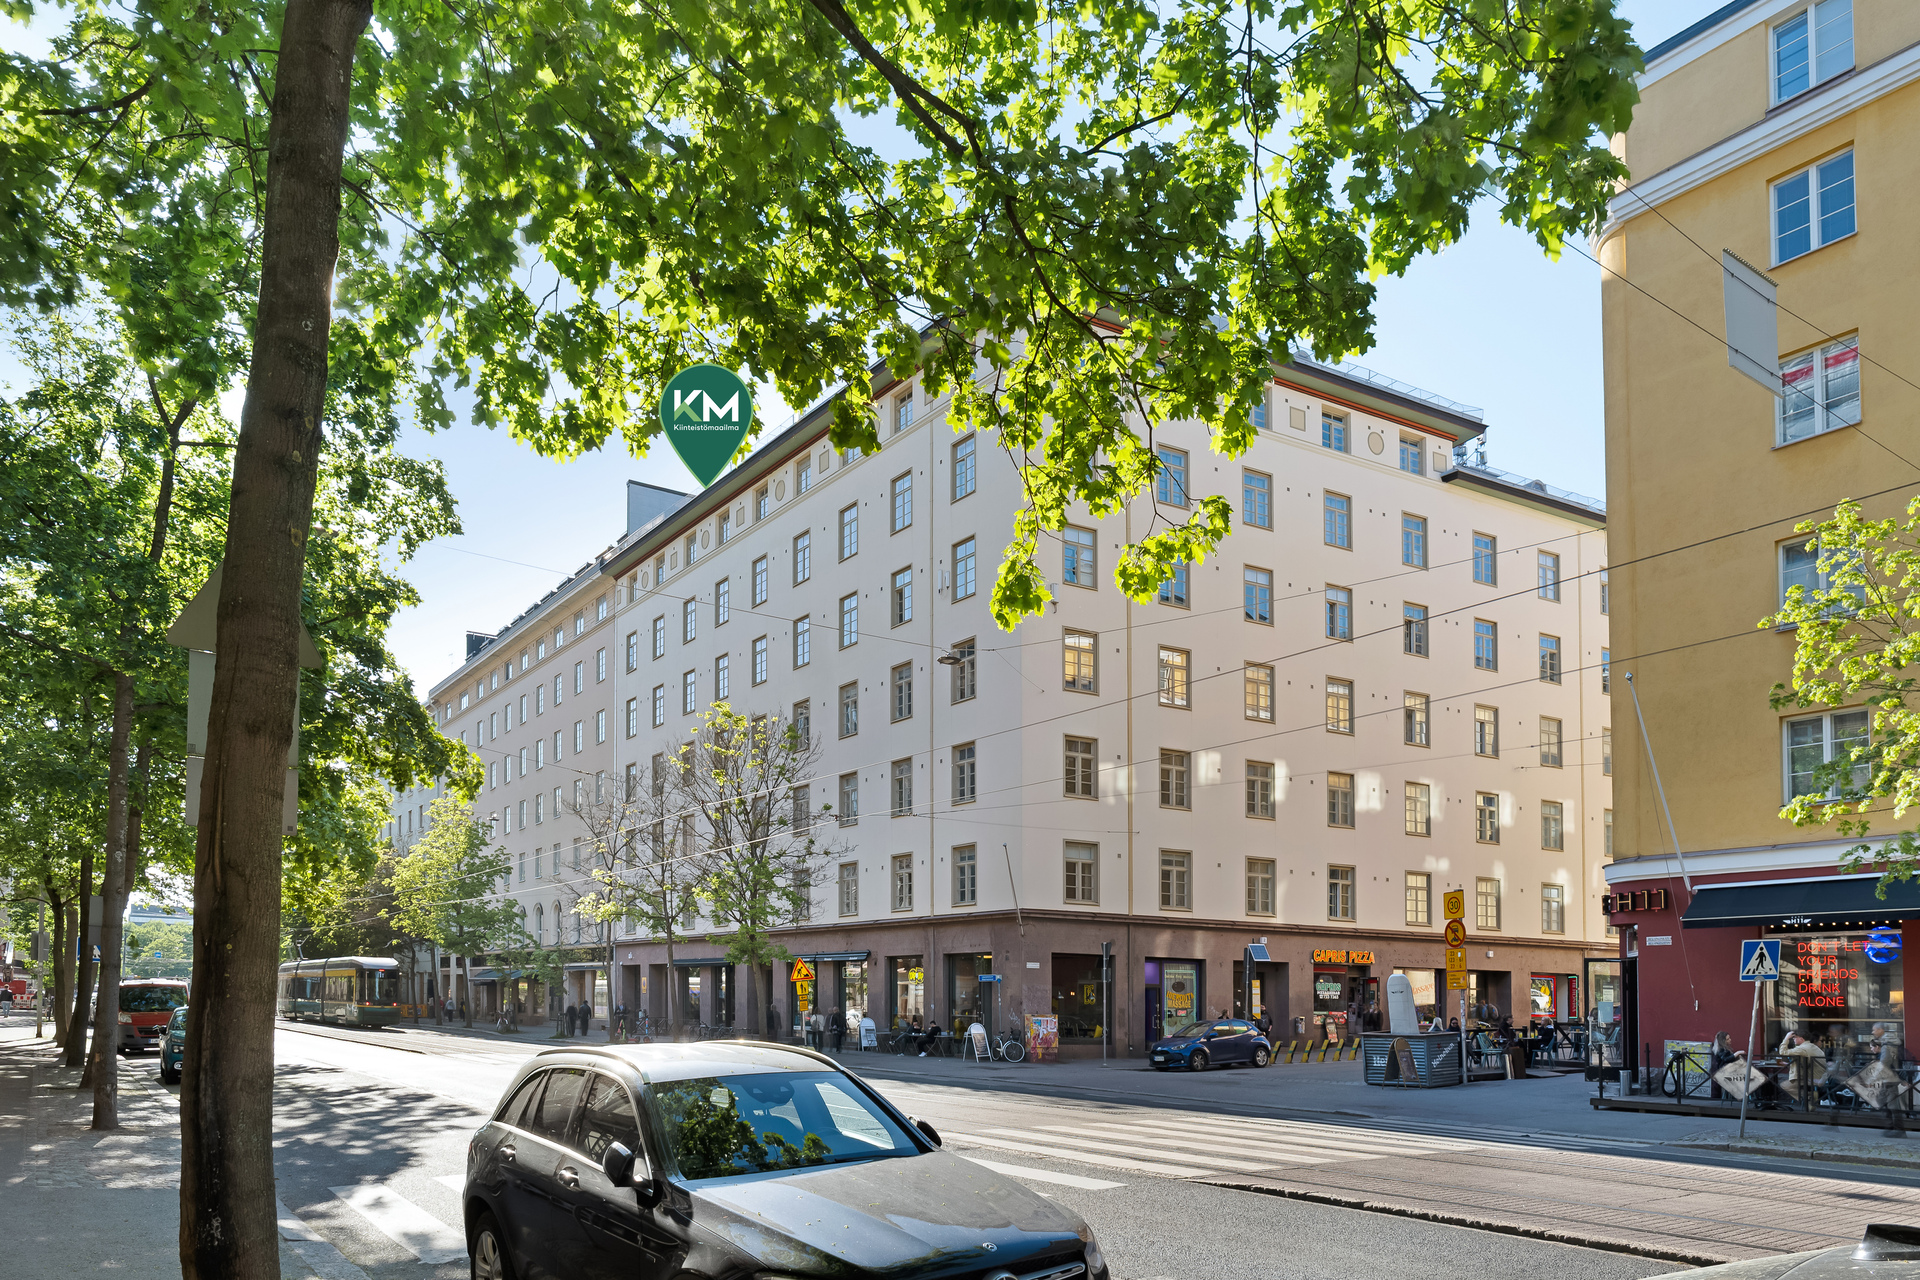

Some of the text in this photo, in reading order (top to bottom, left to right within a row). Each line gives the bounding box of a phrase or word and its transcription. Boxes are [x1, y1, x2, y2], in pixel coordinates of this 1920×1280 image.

[1449, 901, 1459, 910] 30
[1616, 889, 1665, 911] H11
[1797, 940, 1870, 953] DON'T LET
[1313, 949, 1375, 964] CAPRIS PIZZA
[1797, 955, 1837, 966] YOUR
[1798, 968, 1858, 980] FRIENDS
[1316, 982, 1341, 991] CAPRIS
[1412, 983, 1434, 995] assage
[1798, 982, 1841, 993] DRINK
[1798, 996, 1845, 1007] ALONE
